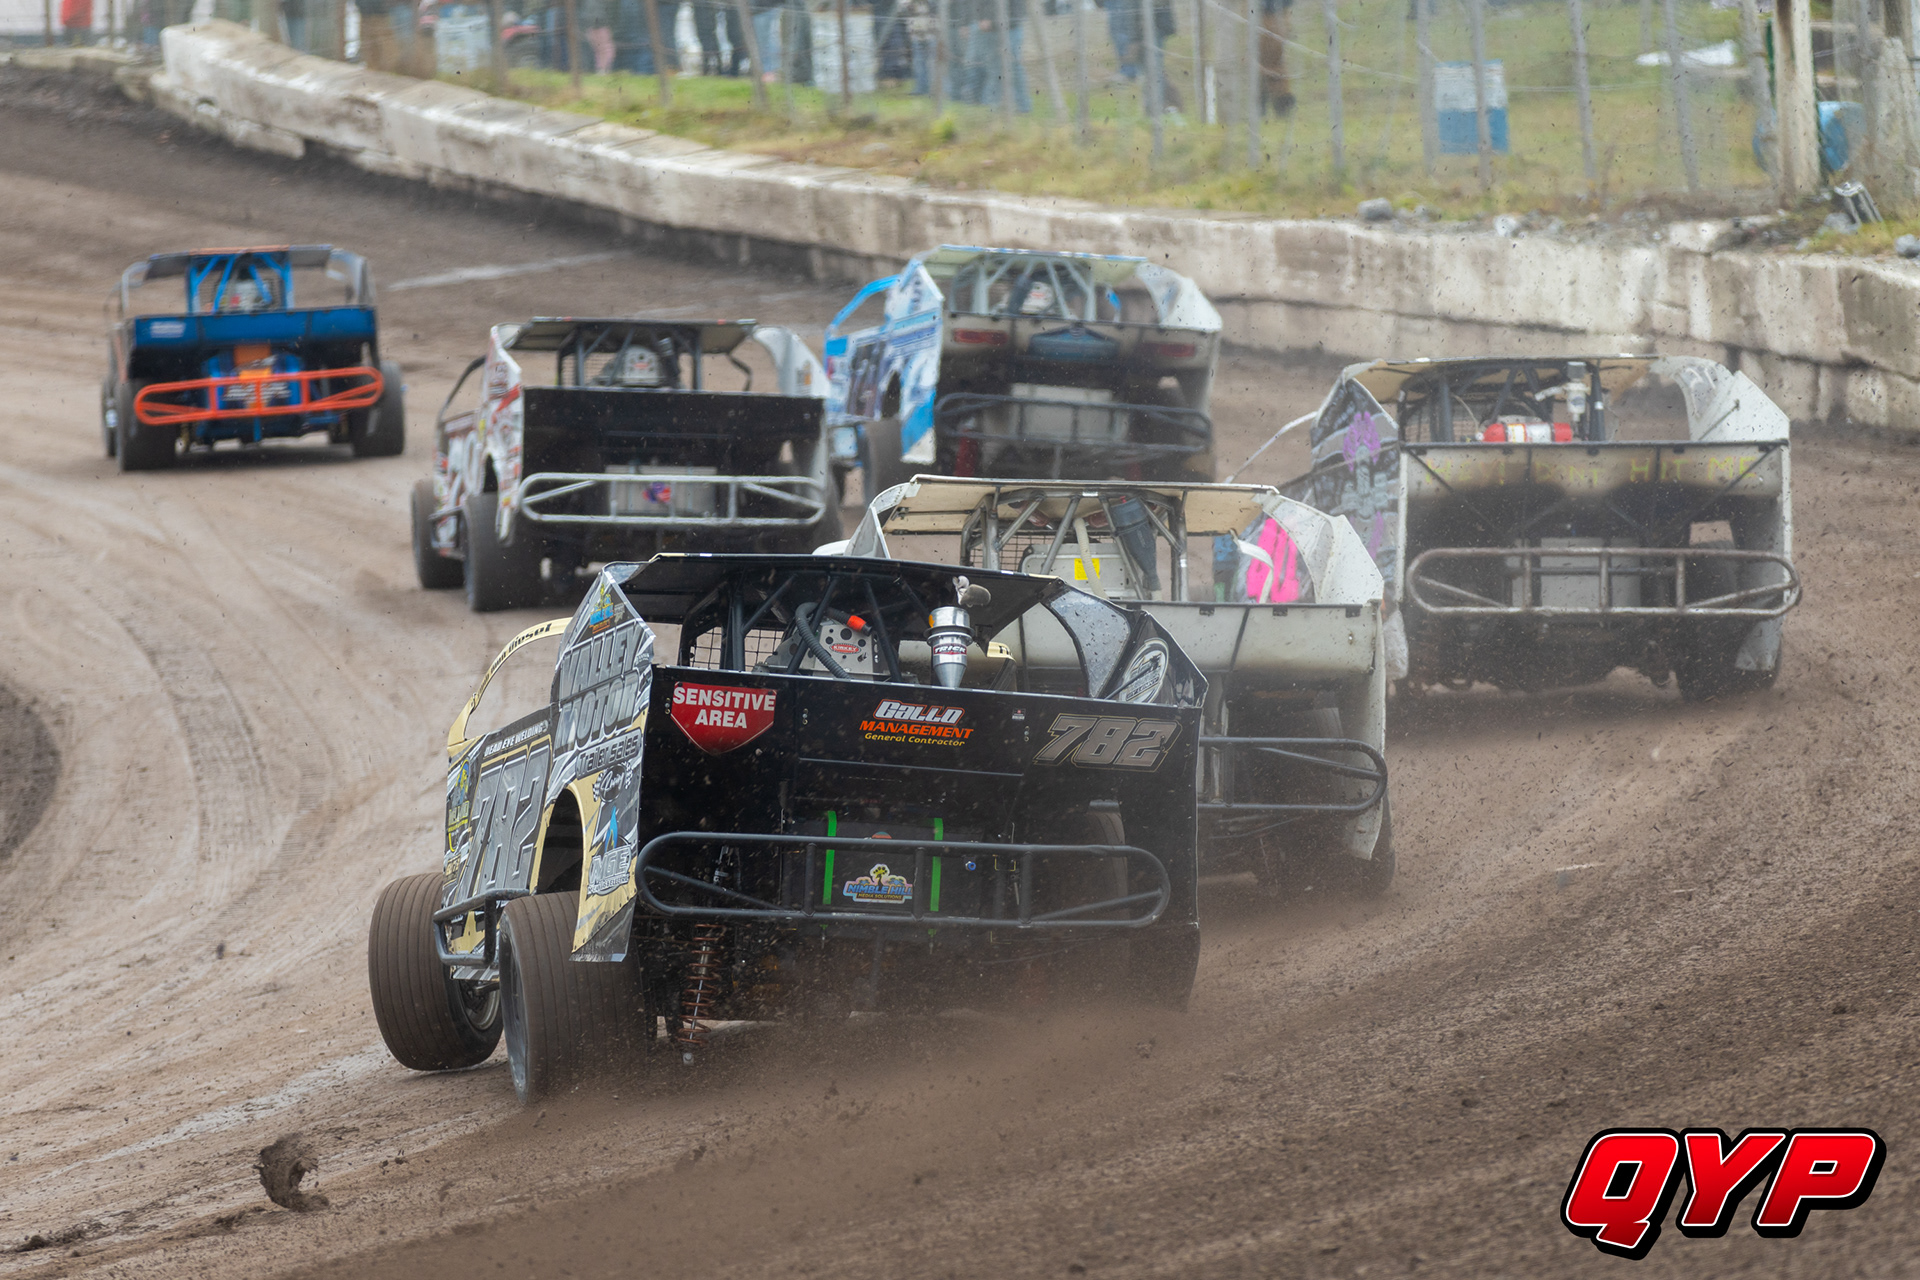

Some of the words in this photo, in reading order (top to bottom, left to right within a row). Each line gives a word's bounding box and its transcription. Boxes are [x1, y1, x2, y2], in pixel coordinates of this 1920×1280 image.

[1629, 457, 1690, 483] HIT
[1708, 455, 1758, 481] ME
[934, 643, 966, 654] TRICK
[672, 686, 777, 712] SENSITIVE
[694, 708, 748, 729] AREA
[859, 720, 975, 739] MANAGEMENT
[864, 732, 907, 743] General
[908, 735, 966, 747] Contractor
[1033, 714, 1181, 770] 782
[453, 746, 551, 904] 782
[847, 884, 889, 895] NIMBLE
[889, 884, 912, 896] HILL
